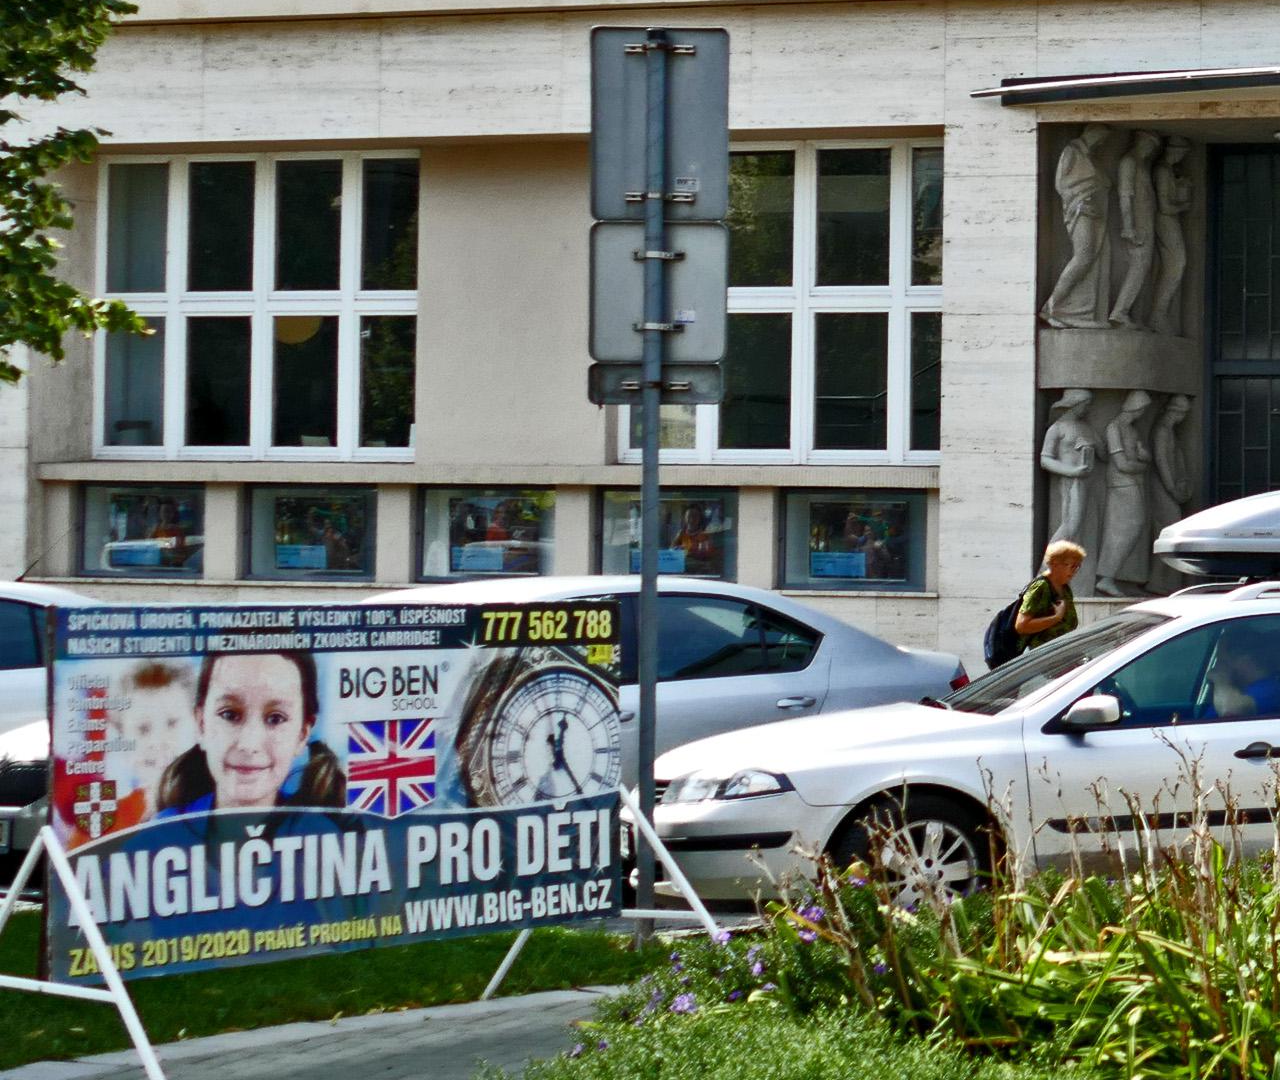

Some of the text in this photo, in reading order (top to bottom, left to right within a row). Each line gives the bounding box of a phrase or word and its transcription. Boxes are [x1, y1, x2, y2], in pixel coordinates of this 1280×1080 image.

[200, 608, 295, 629] PROKAZATELNÉ
[298, 607, 361, 627] VÝSLEDKY!
[365, 609, 396, 626] 100%
[400, 606, 467, 625] ÚSPĚŠNOST
[482, 609, 612, 641] 777 562 788
[67, 634, 119, 655] NAŠICH
[207, 631, 310, 651] MEZINÁRODNÍCH
[313, 629, 368, 649] ZKOUŠEK
[371, 629, 440, 647] CAMBRIDGE!
[339, 664, 438, 698] BIG BEN
[392, 697, 438, 712] SCHOOL
[67, 823, 392, 927] ANGLIČTINA
[406, 818, 501, 889] PRO
[517, 802, 612, 877] DĚTI
[405, 878, 612, 935] WWW.BIG-BEN.CZ
[142, 928, 249, 967] 2019/2020
[254, 921, 305, 953] PRÁVĚ
[310, 913, 377, 945] PROBÍHÁ
[380, 915, 403, 936] NA
